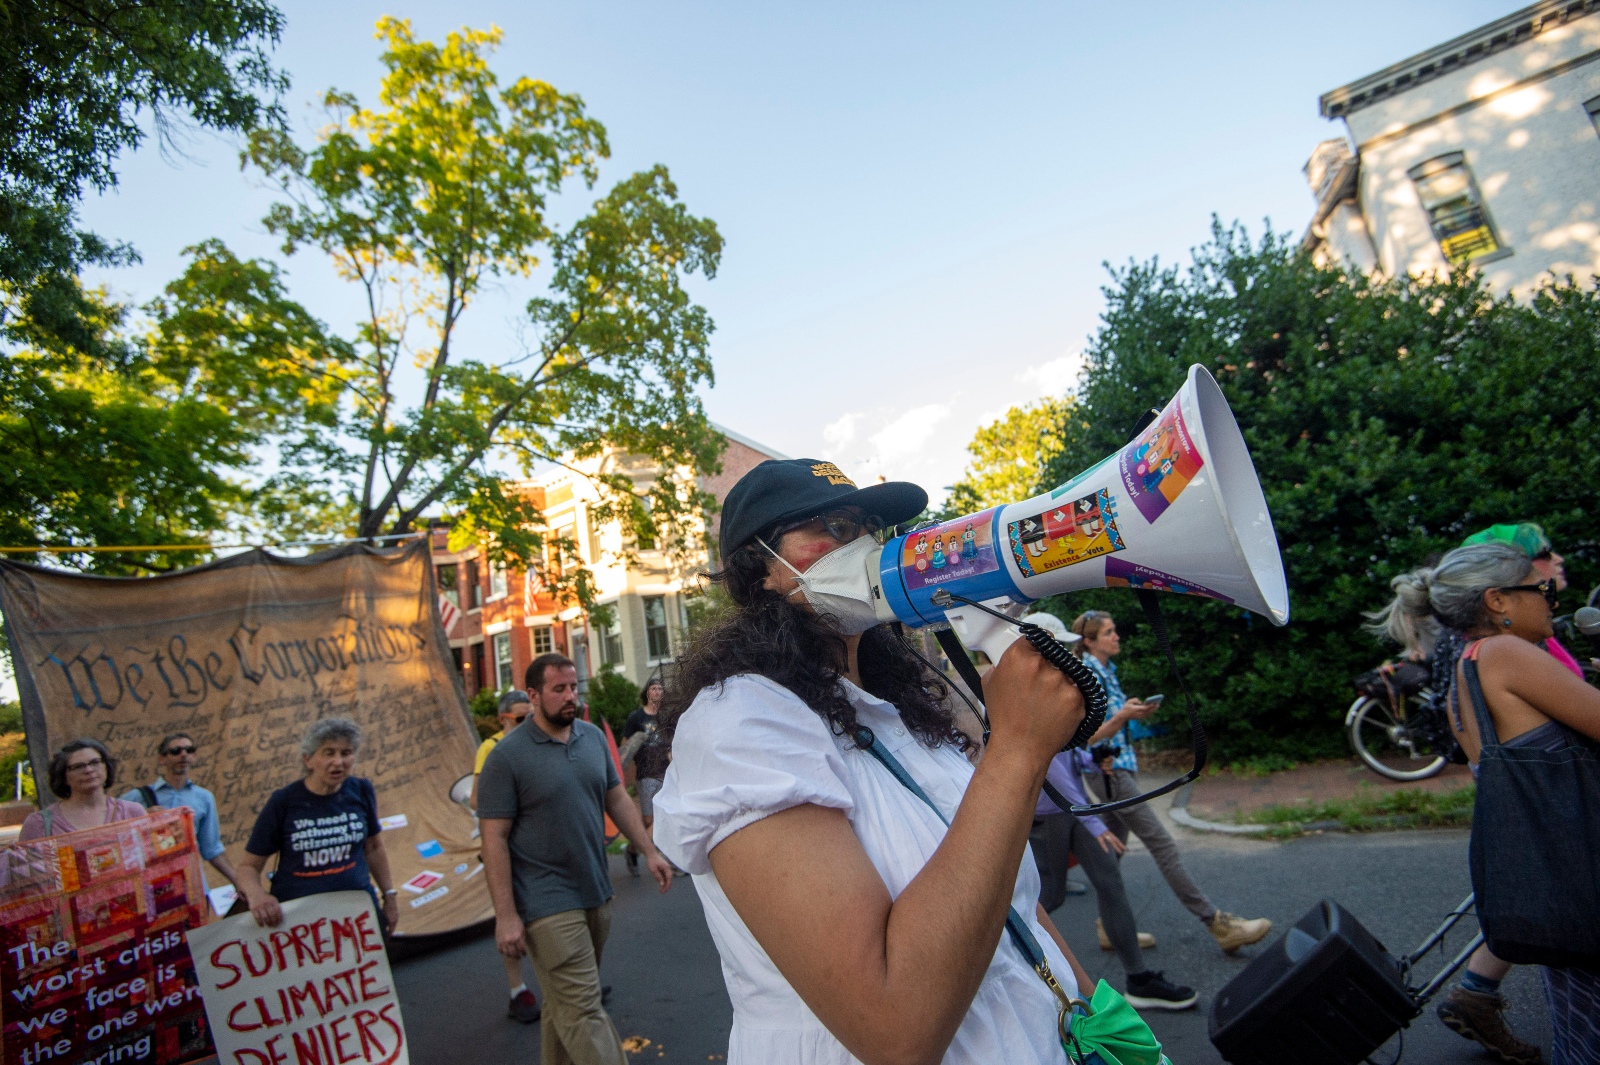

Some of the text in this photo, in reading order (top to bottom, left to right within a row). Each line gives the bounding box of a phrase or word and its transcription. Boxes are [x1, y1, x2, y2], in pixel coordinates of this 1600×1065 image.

[1123, 472, 1140, 498] Today!
[1043, 546, 1105, 569] Existence Vote
[924, 567, 975, 584] Register Today!
[1135, 566, 1207, 592] Register Today!
[38, 641, 153, 717] We
[152, 634, 232, 708] the
[291, 821, 364, 842] pathway to
[293, 812, 358, 829] We need a
[292, 831, 364, 851] citizenship
[303, 844, 352, 867] NOW!
[8, 940, 71, 971] The
[210, 910, 383, 990] SUPREME
[10, 930, 182, 1002] worst crisis
[17, 963, 177, 1034] we face is
[227, 960, 390, 1032] CLIMATE
[19, 1038, 72, 1065] the
[87, 1010, 138, 1041] one
[82, 1036, 151, 1065] ring
